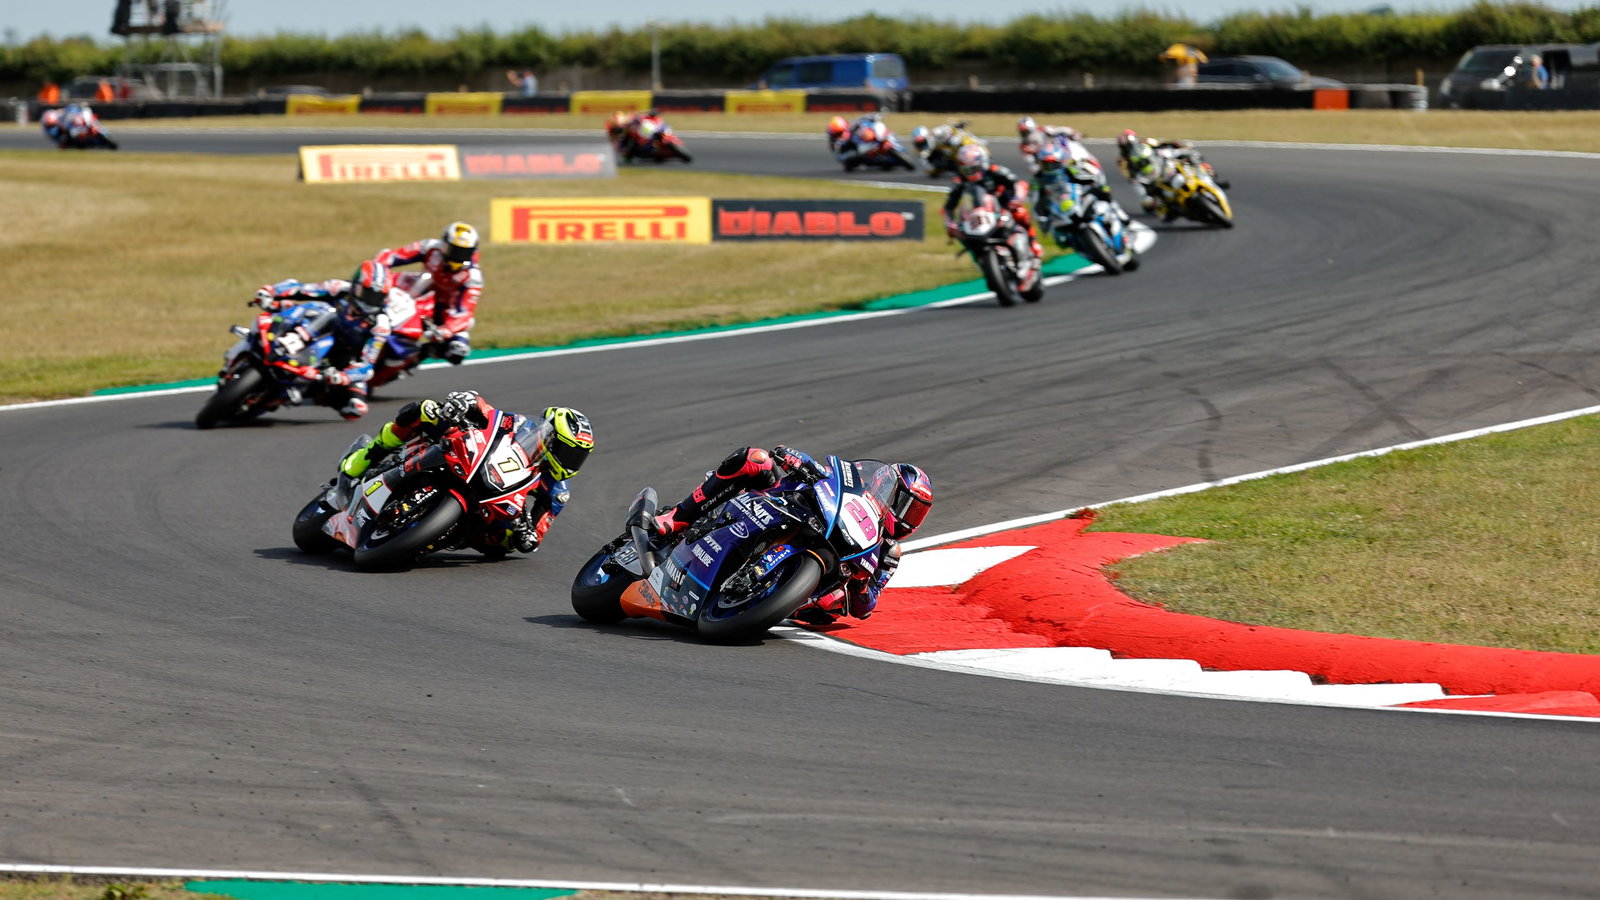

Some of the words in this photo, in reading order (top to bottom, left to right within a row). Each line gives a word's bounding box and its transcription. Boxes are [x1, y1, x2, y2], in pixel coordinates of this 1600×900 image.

[512, 206, 689, 241] PIRELLI
[718, 207, 906, 236] DIABLO
[498, 457, 520, 474] 1
[365, 480, 384, 497] 1
[844, 498, 877, 541] 28
